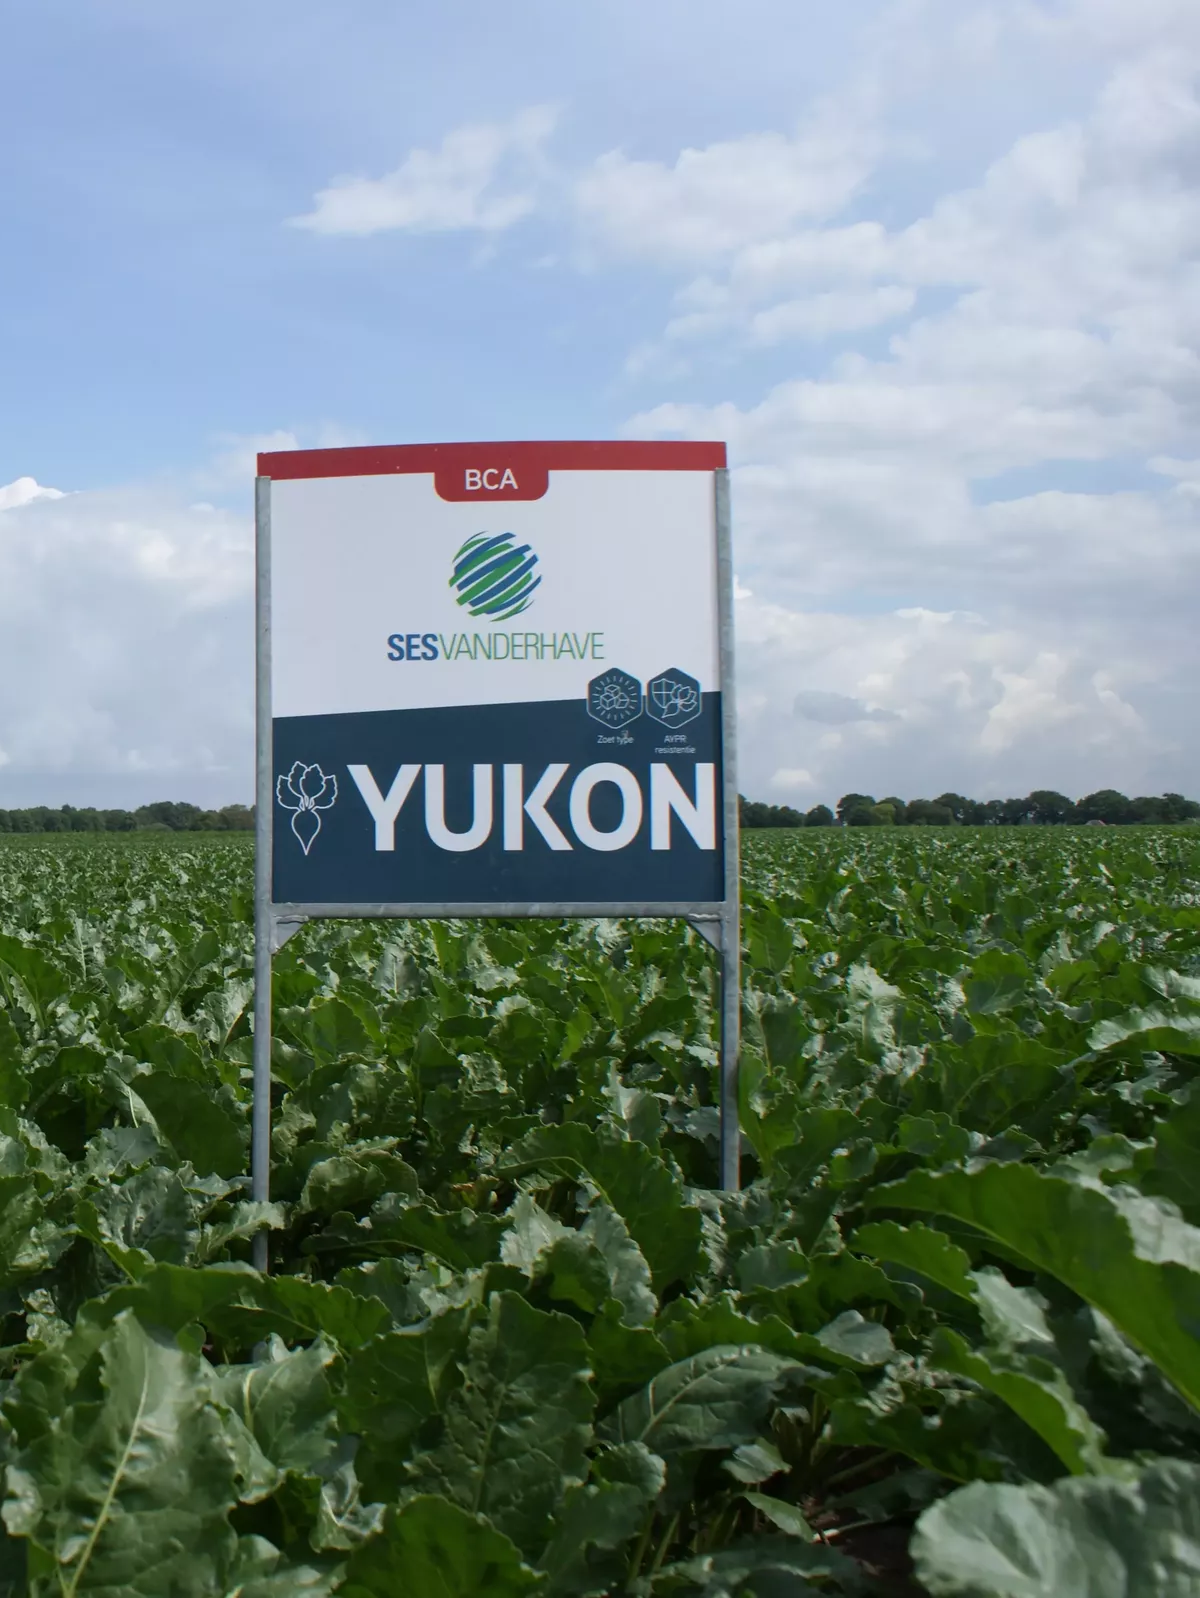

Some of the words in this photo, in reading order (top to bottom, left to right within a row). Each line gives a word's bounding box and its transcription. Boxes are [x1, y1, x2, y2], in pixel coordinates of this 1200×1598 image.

[464, 468, 519, 490] BCA
[387, 632, 605, 661] SESVANDERHAVE
[597, 735, 615, 744] Zoet
[616, 735, 634, 746] type
[654, 746, 696, 754] resistentie
[346, 762, 716, 852] YUKON
